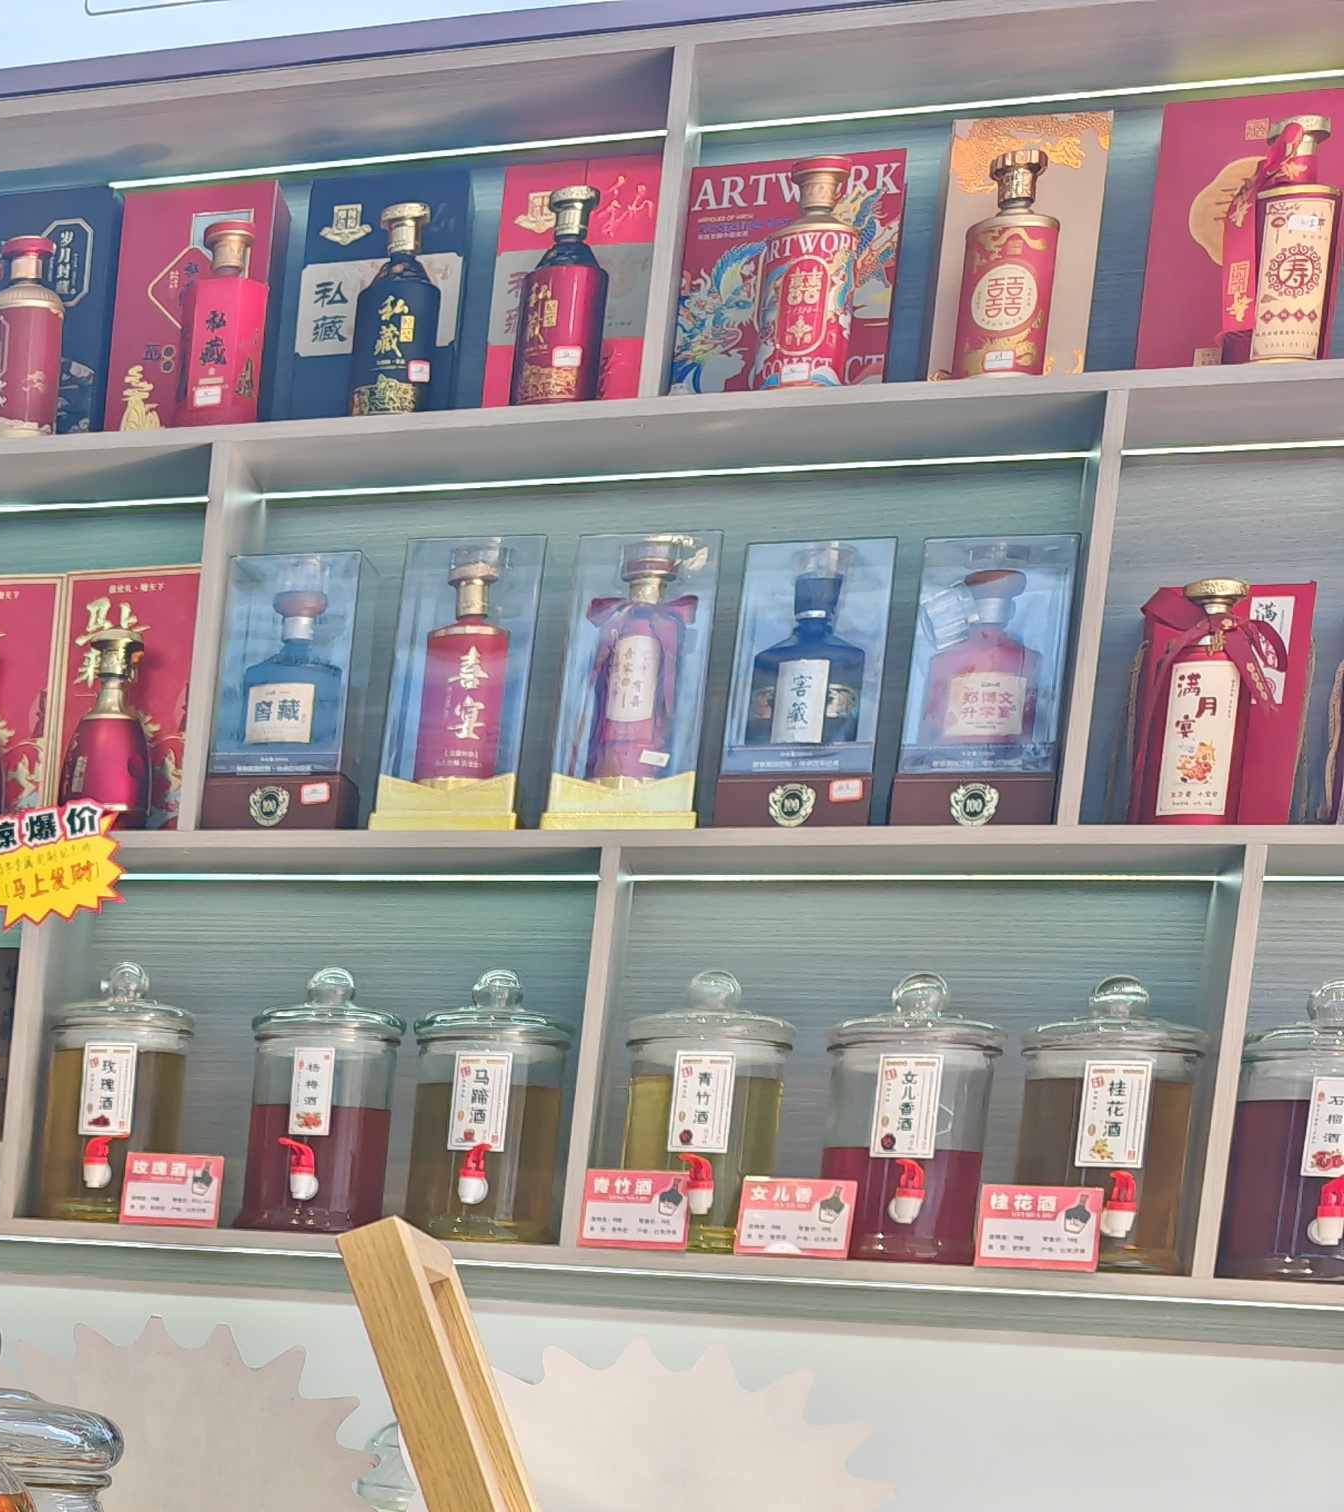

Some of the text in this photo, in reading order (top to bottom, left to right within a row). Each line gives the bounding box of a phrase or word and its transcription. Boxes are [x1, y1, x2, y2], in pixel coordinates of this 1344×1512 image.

[691, 162, 901, 212] ARTWRK
[1284, 259, 1309, 288] 寿
[312, 281, 349, 343] 私藏
[447, 646, 490, 741] 喜宴
[1176, 673, 1217, 739] 满月宴
[695, 1071, 712, 1124] 青竹酒
[897, 1071, 919, 1131] 女儿香酒
[1102, 1079, 1127, 1138] 桂花酒
[990, 1193, 1056, 1212] 桂花酒
